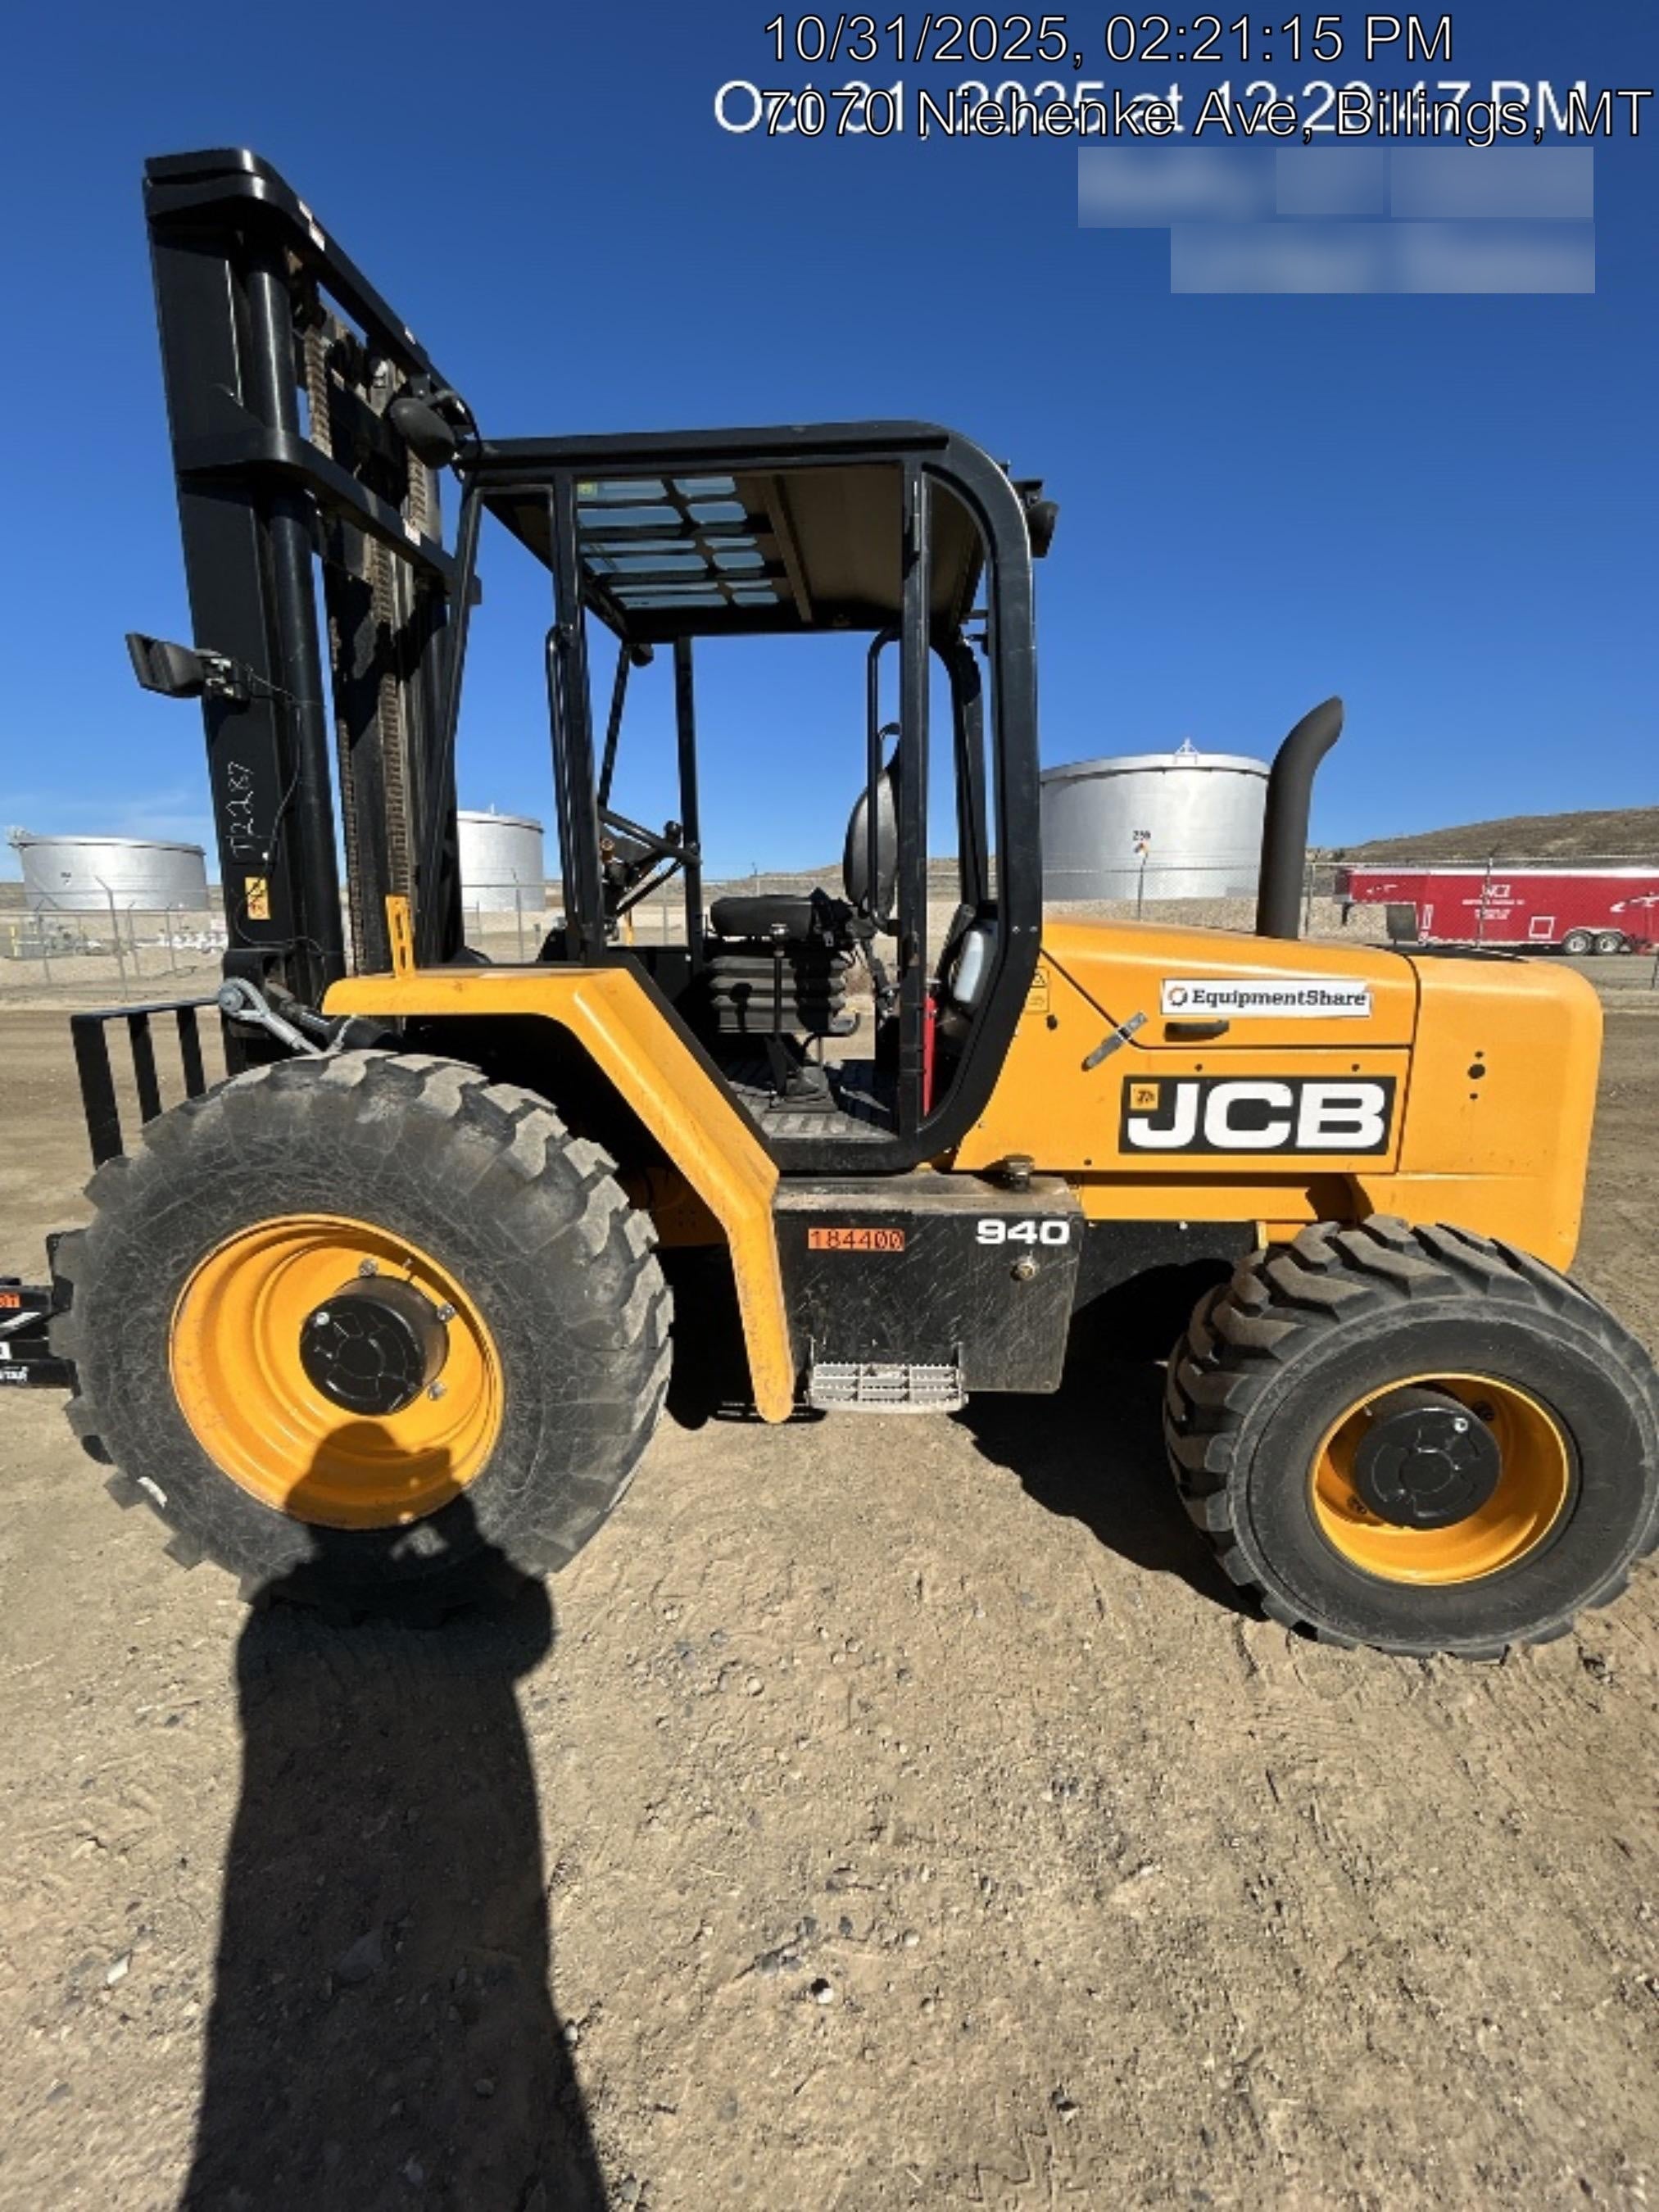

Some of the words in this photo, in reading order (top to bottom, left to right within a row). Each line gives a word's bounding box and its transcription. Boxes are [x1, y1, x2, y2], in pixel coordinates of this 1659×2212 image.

[1191, 988, 1367, 1009] EquipmentShare
[1126, 1081, 1385, 1149] JCB
[809, 1229, 904, 1250] 184400
[975, 1218, 1070, 1245] 940
